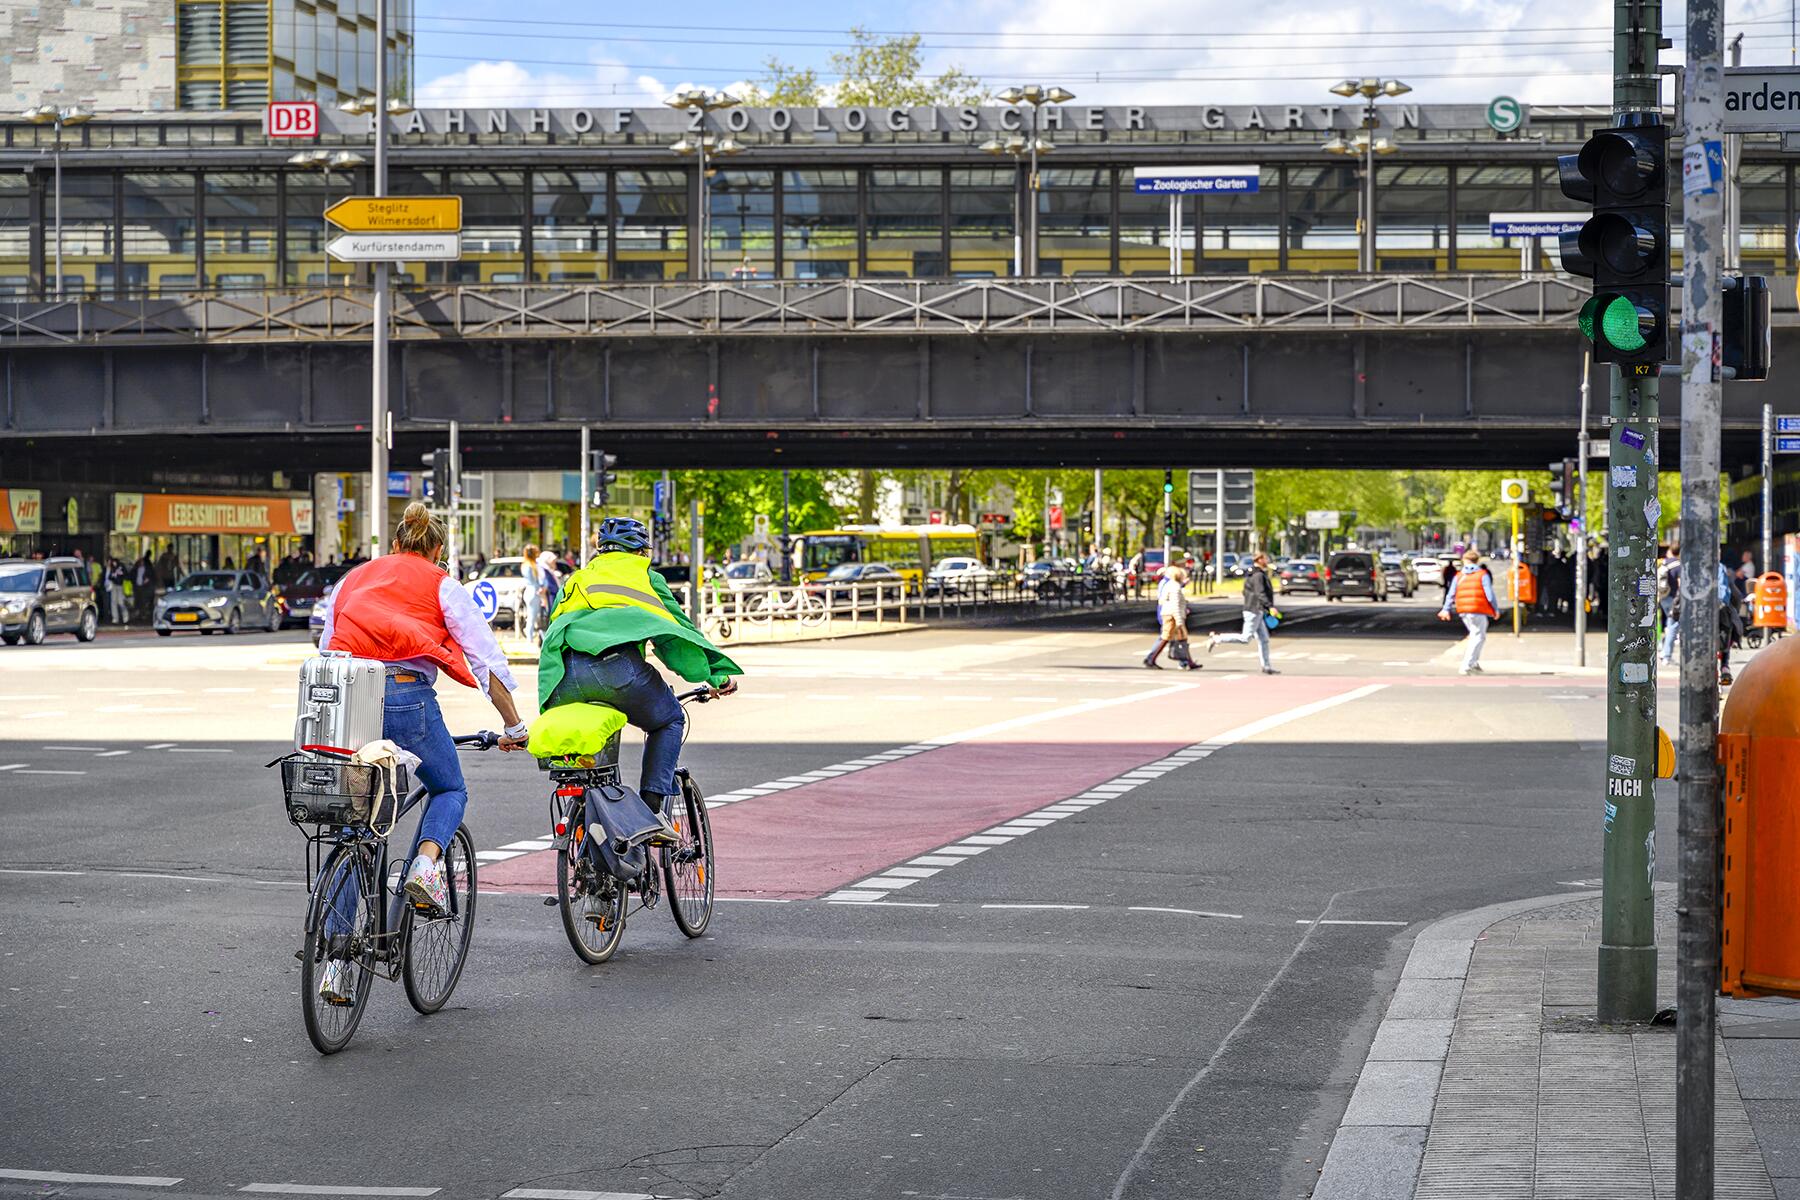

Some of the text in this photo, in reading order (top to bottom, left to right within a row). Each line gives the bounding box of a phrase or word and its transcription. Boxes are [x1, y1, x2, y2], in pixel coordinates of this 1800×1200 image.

[275, 108, 312, 131] DB
[687, 105, 1145, 131] ZOOLOGISCHER
[1202, 104, 1419, 129] GARTEN
[1493, 100, 1517, 128] S
[1153, 179, 1213, 191] Zoologischer
[1214, 178, 1248, 189] Garten
[368, 203, 409, 215] Steglitz
[368, 215, 436, 226] Wilmersdorf
[352, 242, 445, 252] Kurfürstendamm
[1635, 365, 1649, 375] K7
[17, 500, 38, 518] HIT
[117, 503, 137, 519] HIT
[296, 508, 311, 522] HIT
[1608, 778, 1642, 797] FACH
